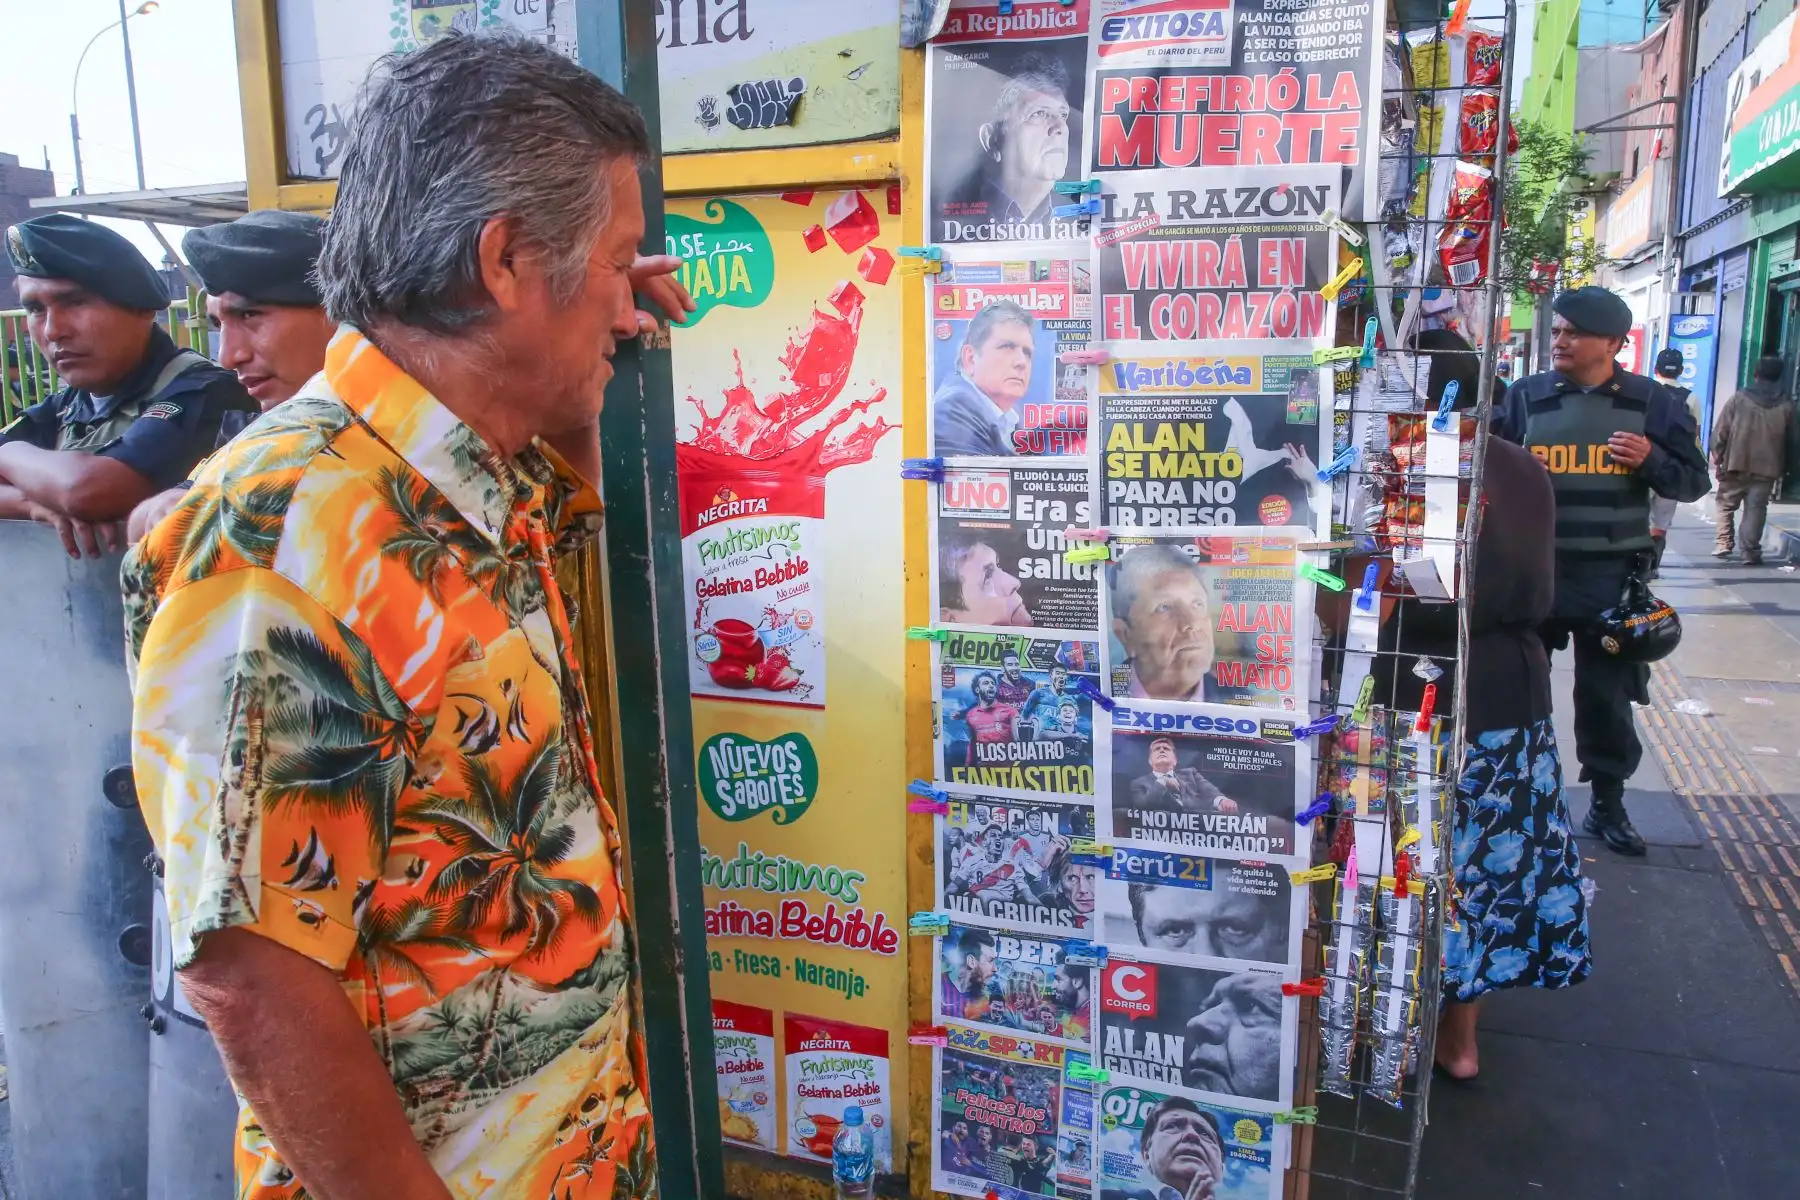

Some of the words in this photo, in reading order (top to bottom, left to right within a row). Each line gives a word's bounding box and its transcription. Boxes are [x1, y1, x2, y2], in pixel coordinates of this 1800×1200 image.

[967, 8, 1077, 35] República
[1239, 12, 1272, 23] ALAN
[1274, 10, 1317, 23] GARCÍA
[1319, 9, 1332, 20] SE
[1334, 3, 1370, 18] QUITÓ
[1101, 12, 1225, 42] EXITOSA
[1244, 26, 1260, 36] LA
[1262, 25, 1292, 36] VIDA
[1294, 22, 1341, 36] CUANDO
[1343, 19, 1363, 31] IBA
[1158, 48, 1185, 56] DIARIO
[1187, 47, 1202, 55] DEL
[1204, 46, 1225, 55] PERÚ
[1243, 40, 1253, 50] A
[1254, 39, 1277, 49] SER
[1279, 35, 1337, 49] DETENIDO
[1338, 33, 1363, 45] POR
[1244, 53, 1257, 63] EL
[1260, 51, 1292, 62] CASO
[1294, 47, 1361, 62] ODEBRECHT
[1102, 68, 1301, 114] PREFIRIÓ
[1304, 70, 1362, 111] LA
[1098, 111, 1361, 167] MUERTE
[1759, 99, 1800, 153] COMID
[1101, 192, 1157, 222] LA
[1167, 182, 1331, 219] RAZÓN
[943, 217, 1044, 242] Decisión
[1050, 216, 1092, 241] fata
[1097, 227, 1127, 246] EDICIÓN
[1126, 216, 1158, 235] ESPECIAL
[1164, 226, 1186, 235] GARCÍA
[1194, 225, 1211, 234] MATÓ
[1235, 224, 1252, 233] AÑOS
[680, 233, 707, 258] SE
[1121, 234, 1248, 290] VIVIRÁ
[1257, 237, 1307, 288] EN
[938, 288, 962, 311] el
[1046, 320, 1063, 329] ALAN
[1063, 319, 1086, 329] GARCÍA
[1103, 293, 1142, 340] EL
[1149, 286, 1327, 340] CORAZÓN
[1058, 343, 1071, 352] QUE
[1062, 332, 1070, 340] LA
[1070, 331, 1086, 340] VIDA
[1113, 360, 1252, 391] Karibeña
[1023, 403, 1088, 429] DECID
[1014, 431, 1044, 456] SU
[1048, 430, 1088, 456] FIN
[1106, 422, 1205, 451] ALAN
[1107, 452, 1144, 478] SE
[1149, 447, 1244, 478] MATÓ
[1529, 444, 1630, 475] POLIC
[1013, 471, 1050, 481] ELUDIÓ
[1051, 471, 1065, 481] LA
[1023, 482, 1043, 492] CON
[1045, 483, 1057, 492] EL
[944, 481, 1008, 509] UNO
[1108, 480, 1187, 504] PARA
[1192, 480, 1236, 504] NO
[698, 498, 768, 527] NEGRITA
[1015, 494, 1068, 522] Era
[1109, 507, 1138, 526] IR
[1142, 506, 1237, 526] PRESO
[727, 555, 749, 569] fresa
[695, 577, 754, 599] Gelatina
[755, 555, 809, 592] Bebible
[776, 587, 788, 601] No
[788, 581, 811, 598] cuaja
[1217, 602, 1293, 633] ALAN
[777, 625, 793, 639] SIN
[1256, 634, 1294, 663] SE
[1217, 657, 1293, 692] MATÓ
[1112, 706, 1257, 734] Expreso
[1264, 722, 1289, 730] EDICIÓN
[708, 737, 802, 779] NUEVOS
[1008, 741, 1065, 761] CUATRO
[1207, 753, 1229, 762] GUSTO
[1252, 757, 1282, 767] RIVALES
[1238, 749, 1252, 757] VOY
[1261, 751, 1275, 759] DAR
[952, 761, 1095, 796] FANTÁSTICO
[1171, 811, 1200, 830] ME
[1203, 813, 1267, 834] VERÁN
[700, 842, 865, 904] rutísimos
[1112, 849, 1176, 878] Perú
[1179, 857, 1208, 881] 21
[1243, 868, 1264, 878] quitó
[1226, 875, 1244, 884] vida
[1245, 877, 1267, 886] antes
[1268, 879, 1278, 887] de
[1241, 886, 1277, 896] detenido
[948, 891, 985, 918] VÍA
[988, 900, 1073, 929] CRUCIS
[704, 902, 775, 938] atina
[780, 900, 899, 954] Bebible
[734, 949, 781, 977] Fresa
[795, 958, 865, 1000] Naranja
[1111, 965, 1147, 1001] C
[1106, 999, 1150, 1012] CORREO
[800, 1039, 851, 1050] NEGRITA
[1104, 1026, 1185, 1068] ALAN
[725, 1059, 764, 1074] Bebible
[797, 1083, 842, 1099] Gelatina
[843, 1082, 880, 1098] Bebible
[955, 1088, 1016, 1115] Felices
[1018, 1103, 1046, 1121] los
[965, 1106, 1036, 1135] CUATRO
